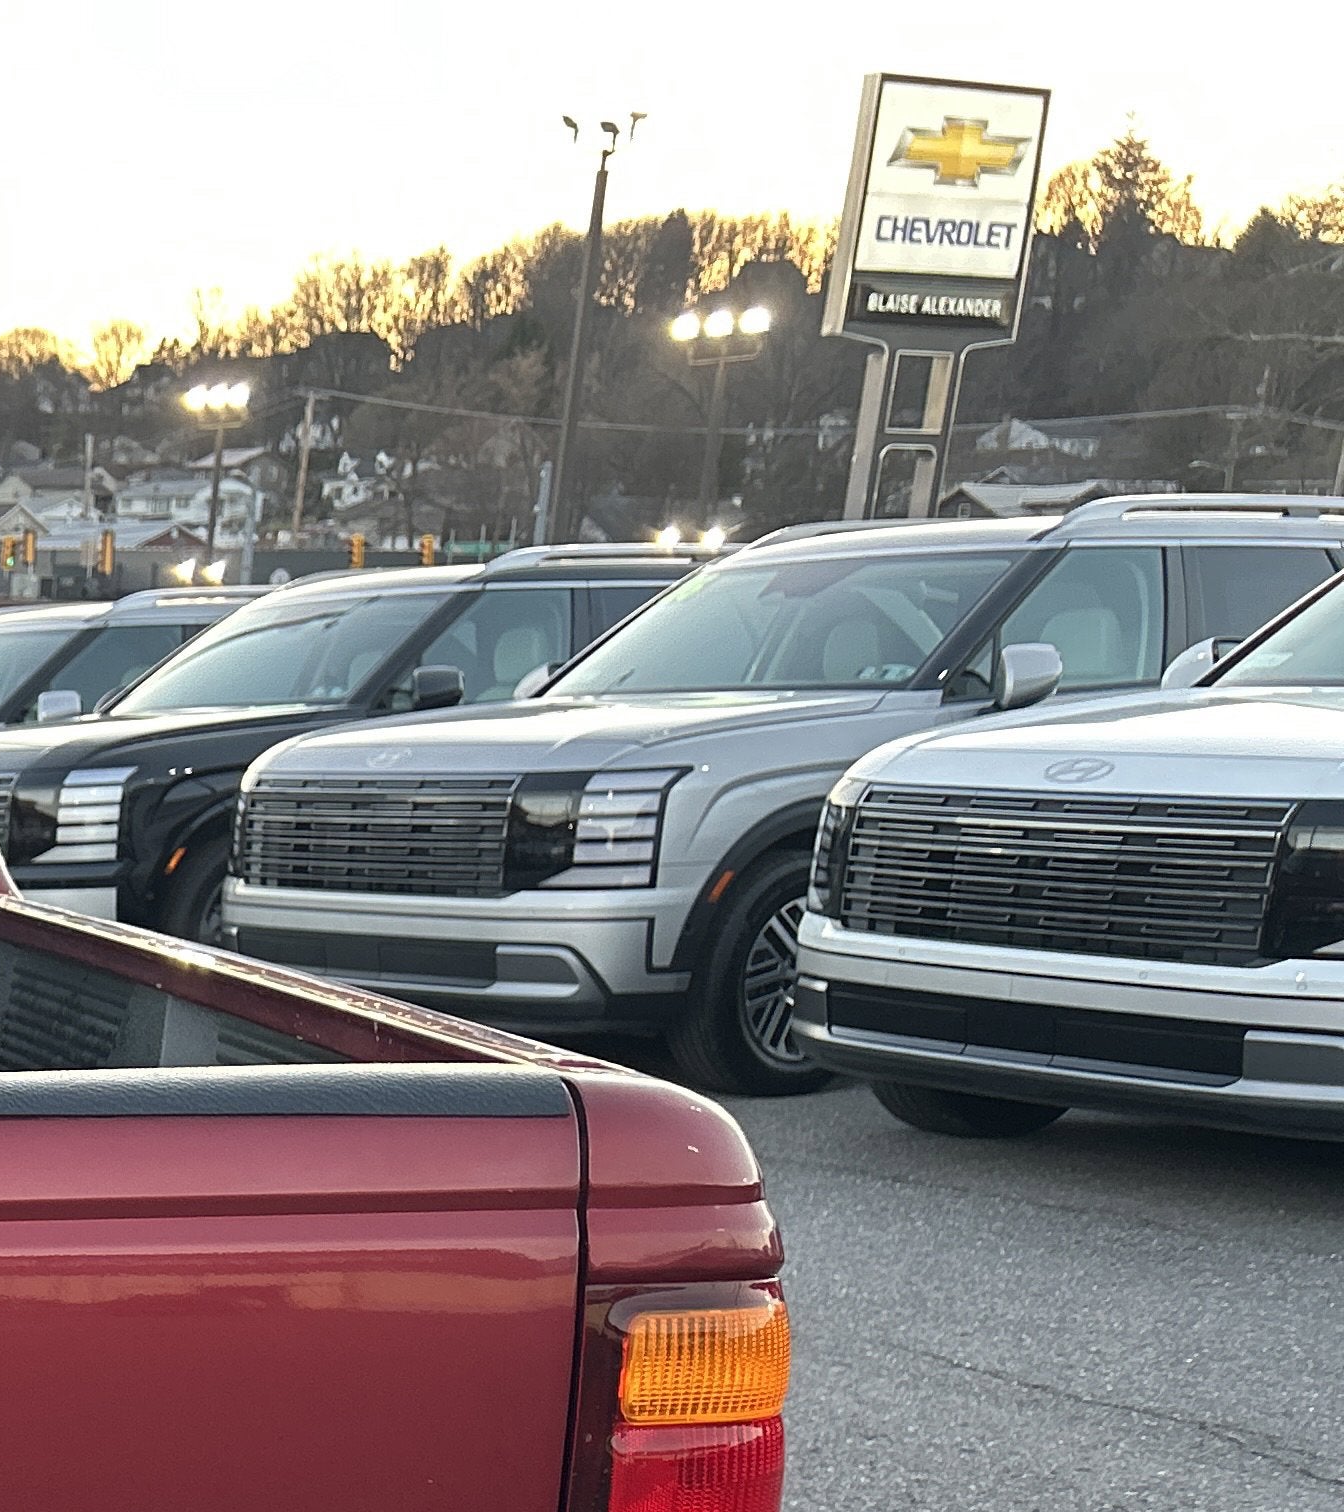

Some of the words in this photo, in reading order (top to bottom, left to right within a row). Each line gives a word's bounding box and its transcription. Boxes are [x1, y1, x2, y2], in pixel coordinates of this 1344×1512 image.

[875, 214, 1018, 249] CHEVROLET
[867, 292, 917, 313] BLAISE
[920, 296, 1002, 318] ALEXANDER
